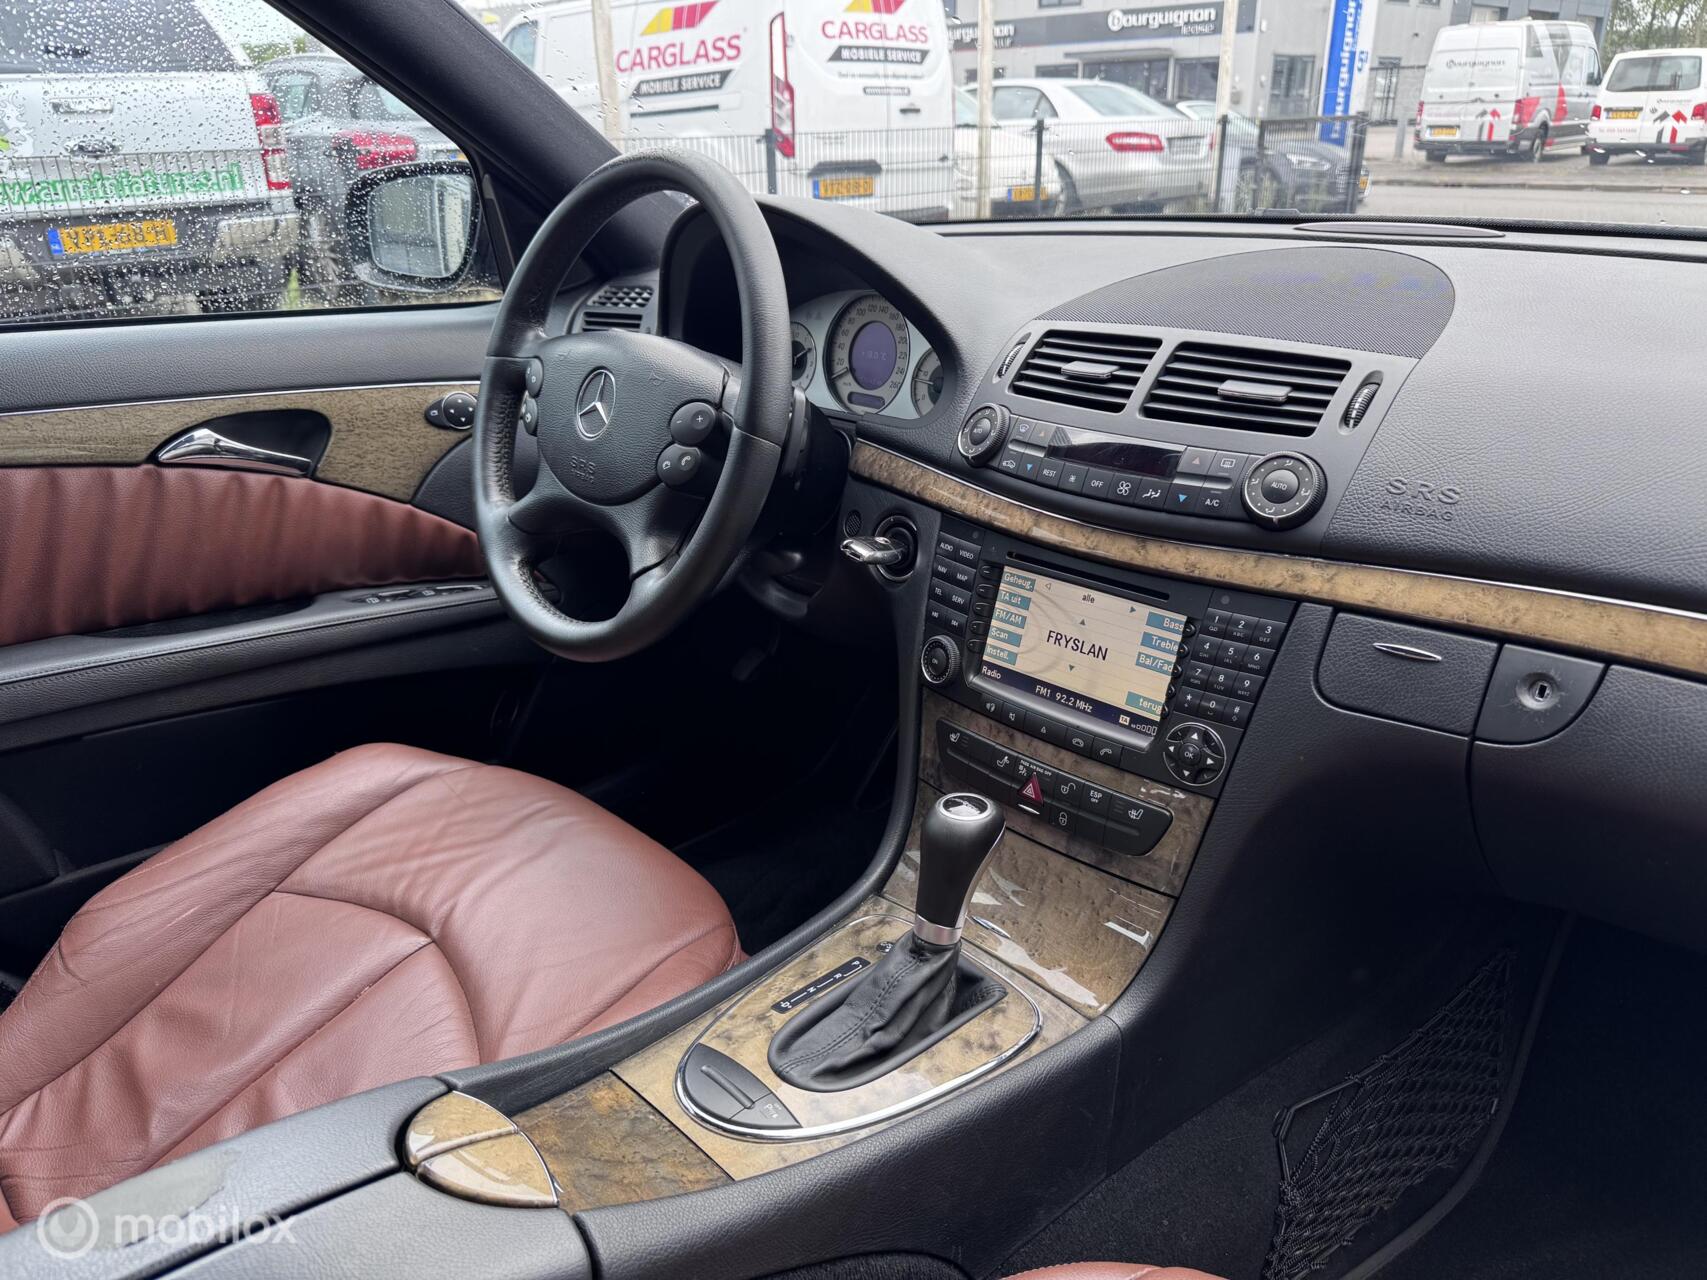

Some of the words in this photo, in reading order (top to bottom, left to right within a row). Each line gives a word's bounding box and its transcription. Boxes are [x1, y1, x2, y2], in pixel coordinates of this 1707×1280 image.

[822, 20, 929, 44] CARGLASS
[615, 34, 741, 73] CARGLASS
[841, 47, 884, 61] MOBIELE
[886, 49, 922, 63] SERVICE
[639, 76, 677, 95] MOBIELE
[680, 70, 722, 92] SERVICE
[570, 455, 597, 474] SRS
[1043, 469, 1057, 478] REST
[1091, 479, 1105, 488] OFF
[1271, 481, 1288, 491] AUTO
[1385, 477, 1461, 505] SRS
[1205, 498, 1220, 508] A/C
[940, 542, 954, 552] AUDIO
[959, 549, 974, 560] VIDEO
[937, 565, 948, 574] NAV
[956, 572, 968, 582] MAP
[934, 587, 943, 596] TEL
[951, 594, 965, 605] SERV
[1000, 591, 1009, 601] TA
[1010, 595, 1021, 605] uit
[1081, 594, 1096, 604] alle
[995, 609, 1022, 625] FM/AM
[1163, 617, 1184, 631] Bass
[1214, 615, 1220, 624] 1
[1238, 620, 1245, 629] 2
[1264, 625, 1272, 634] 3
[991, 627, 1009, 640] Scan
[1046, 629, 1108, 661] FRYSLAN
[1151, 636, 1179, 652] Treble
[1203, 642, 1210, 650] 4
[1227, 647, 1235, 656] 5
[1253, 652, 1261, 661] 6
[1138, 655, 1173, 672] Bal/Fad
[981, 665, 1002, 680] Radio
[1195, 668, 1202, 676] 7
[1218, 674, 1225, 683] 8
[1244, 679, 1251, 688] 9
[1035, 685, 1051, 697] FM1
[1055, 692, 1074, 706] 92.2
[1076, 699, 1093, 713] MHz
[1139, 698, 1162, 716] terug
[1209, 700, 1216, 709] 0
[1184, 751, 1194, 759] OK
[1089, 789, 1103, 799] ESP
[833, 972, 843, 980] R
